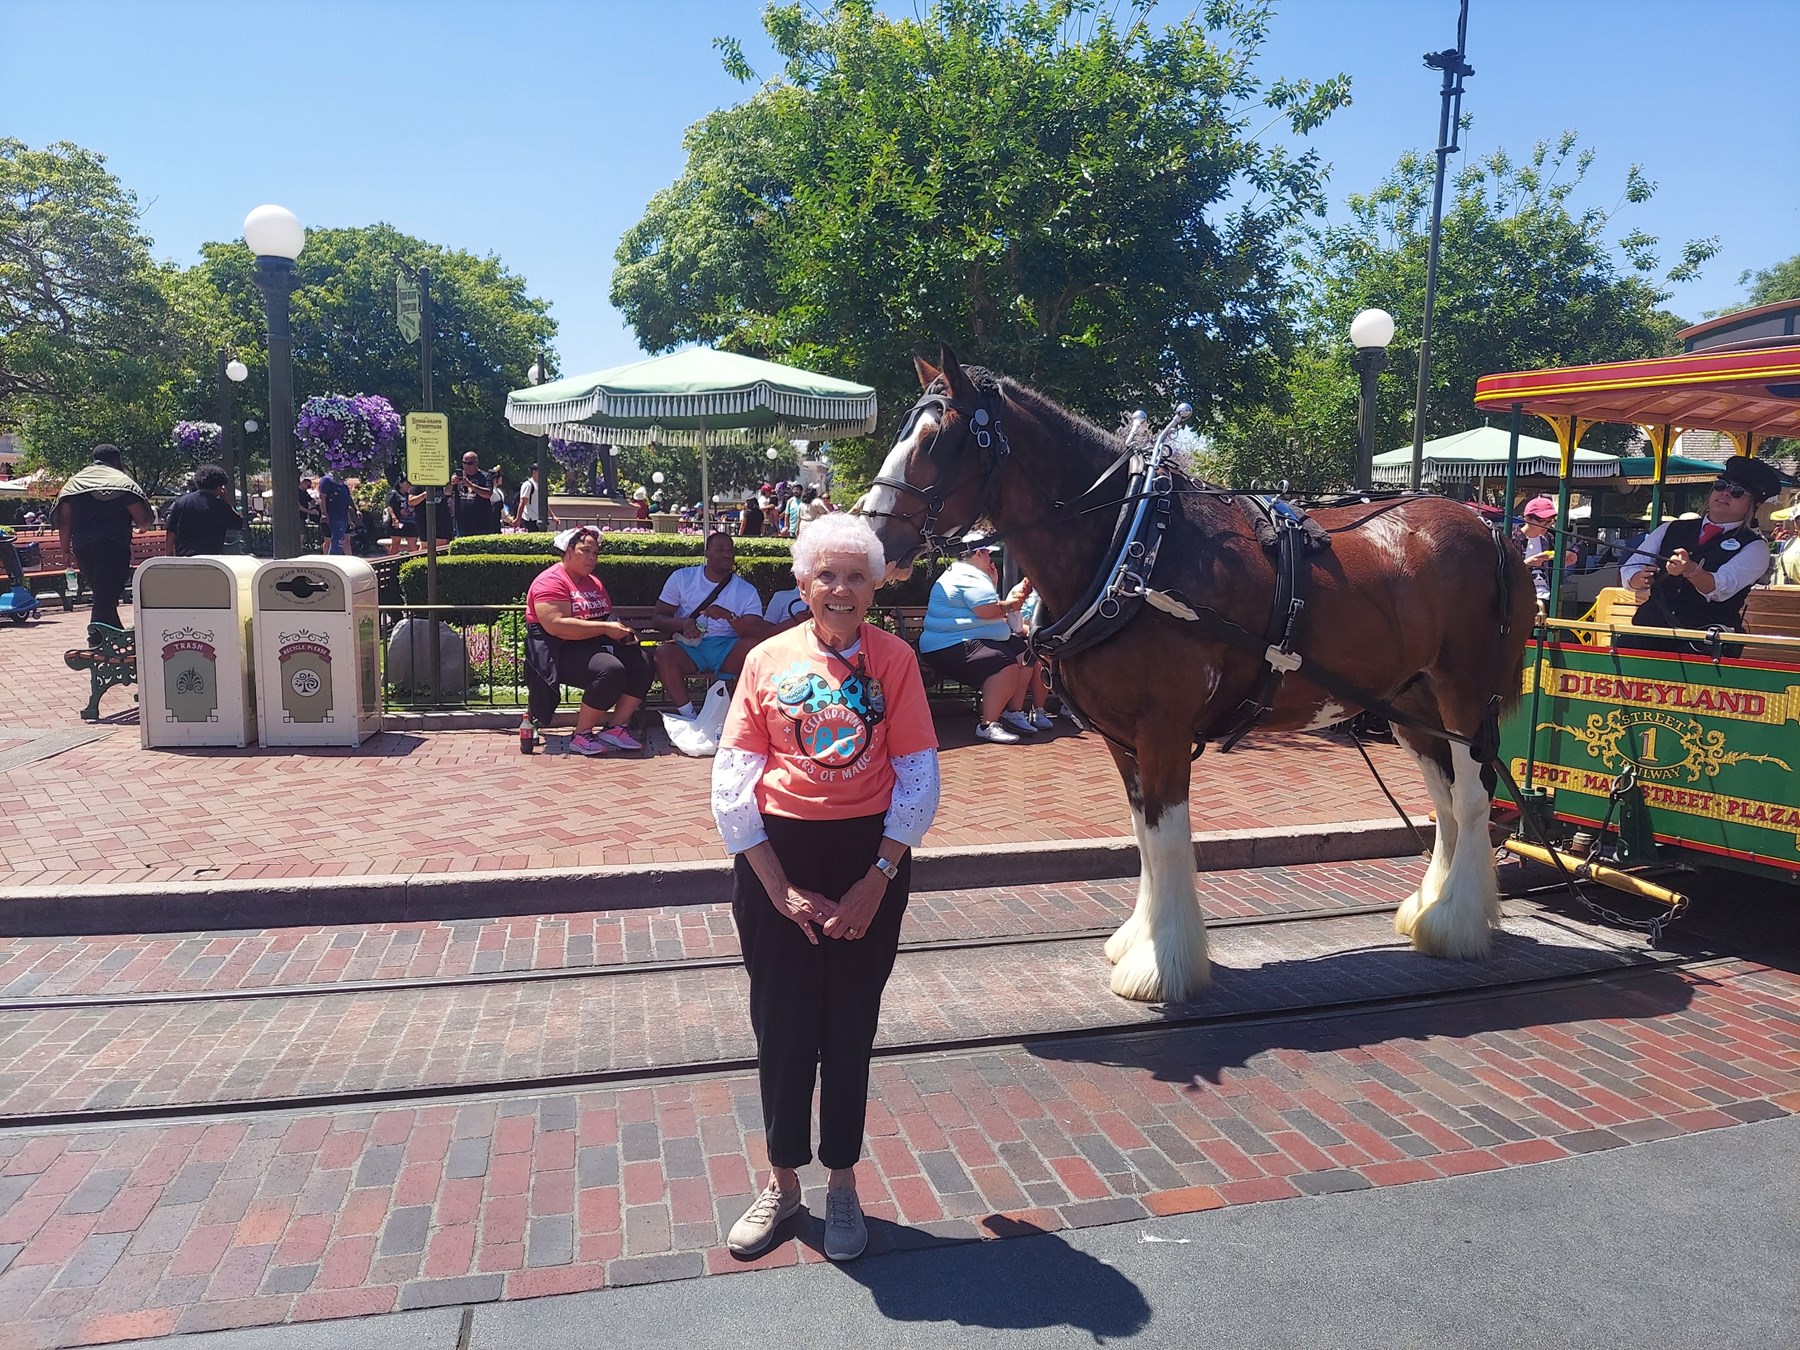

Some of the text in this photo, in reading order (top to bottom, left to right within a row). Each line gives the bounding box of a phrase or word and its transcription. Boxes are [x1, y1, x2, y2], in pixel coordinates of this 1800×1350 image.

[174, 642, 203, 651] TRASH
[282, 644, 328, 655] RECYCLE PLEASE
[1560, 674, 1766, 716] DISNEYLAND
[803, 708, 866, 734] CELEBRATING
[1621, 711, 1686, 731] STREET
[814, 726, 856, 757] 85
[1638, 727, 1659, 762] 1
[819, 770, 836, 782] OF
[1640, 784, 1713, 810] STREET
[1726, 800, 1800, 828] PLAZA
